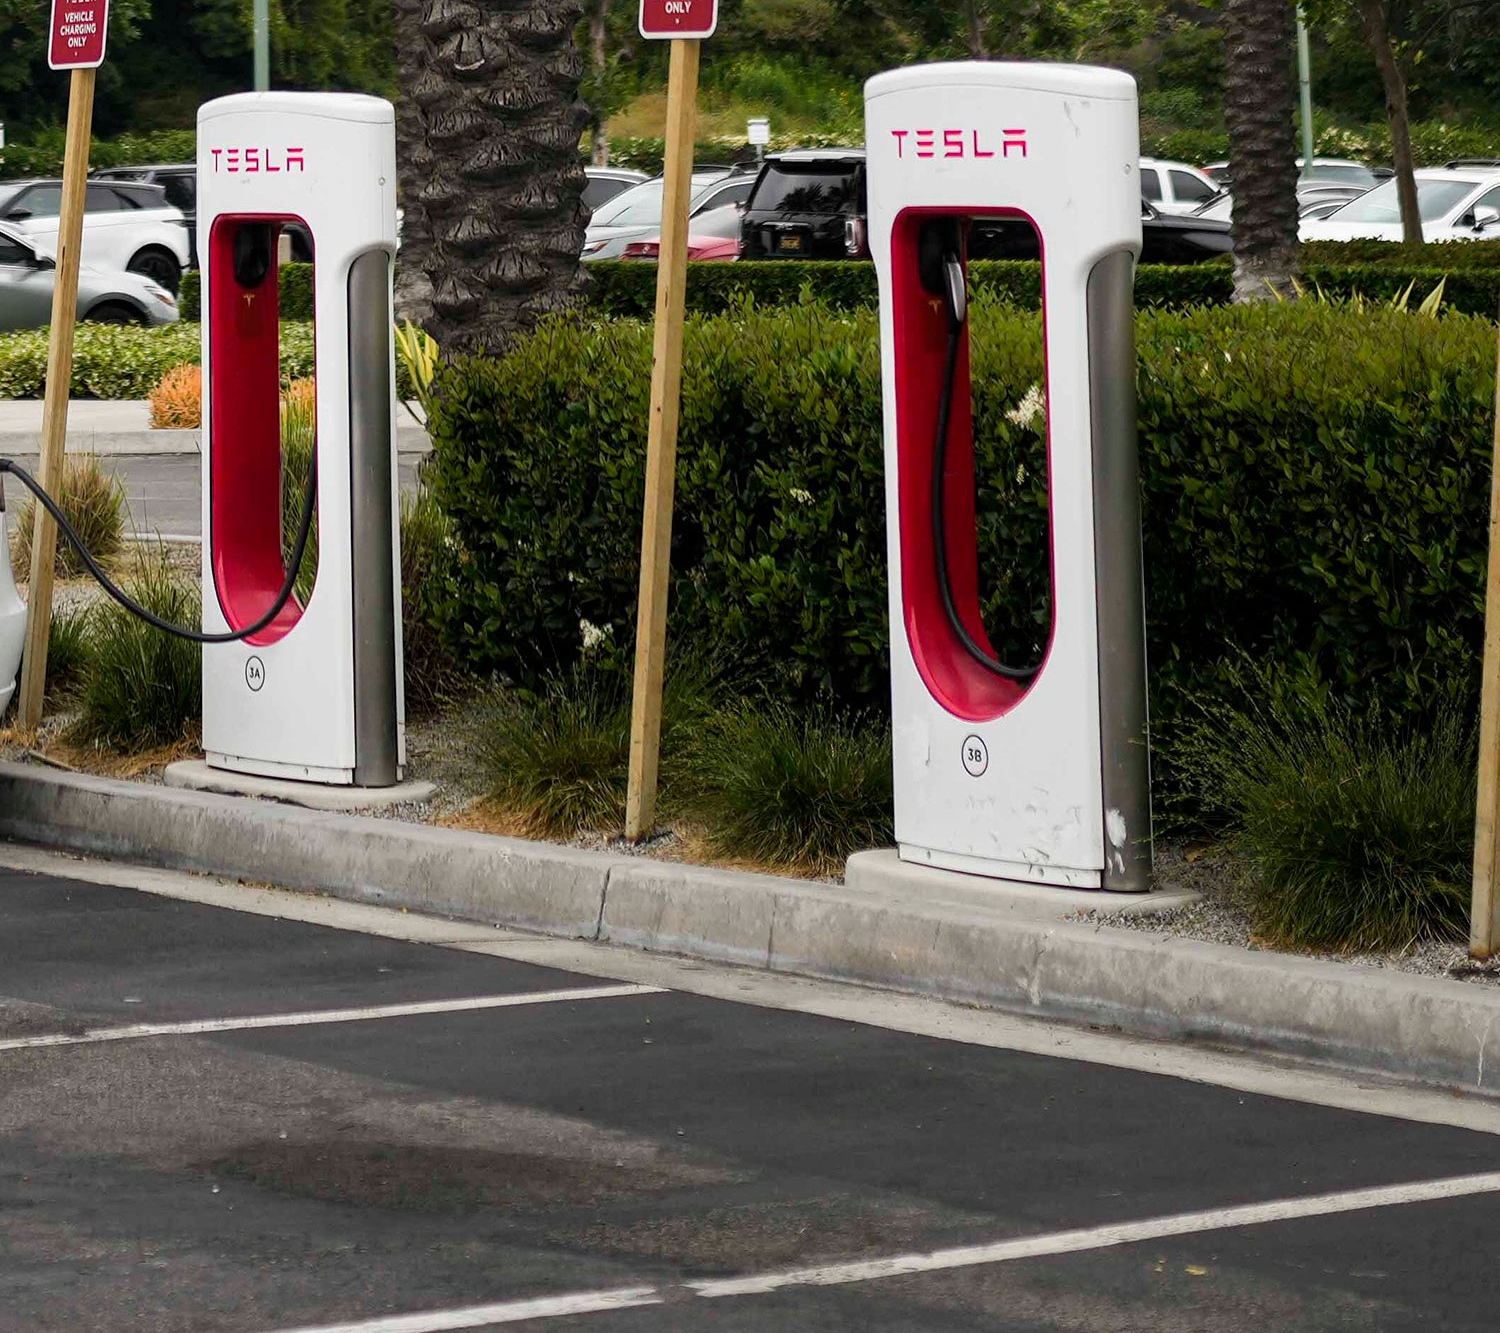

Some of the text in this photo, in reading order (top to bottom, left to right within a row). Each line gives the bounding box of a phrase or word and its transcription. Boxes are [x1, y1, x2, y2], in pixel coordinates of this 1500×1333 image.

[665, 1, 691, 14] ONLY
[64, 11, 94, 23] VEHICLE
[60, 23, 96, 36] CHARGING
[68, 36, 87, 48] ONLY
[891, 129, 1027, 158] TESLA
[211, 148, 304, 172] TESLA
[249, 668, 260, 679] 3A
[967, 748, 982, 763] 3B
